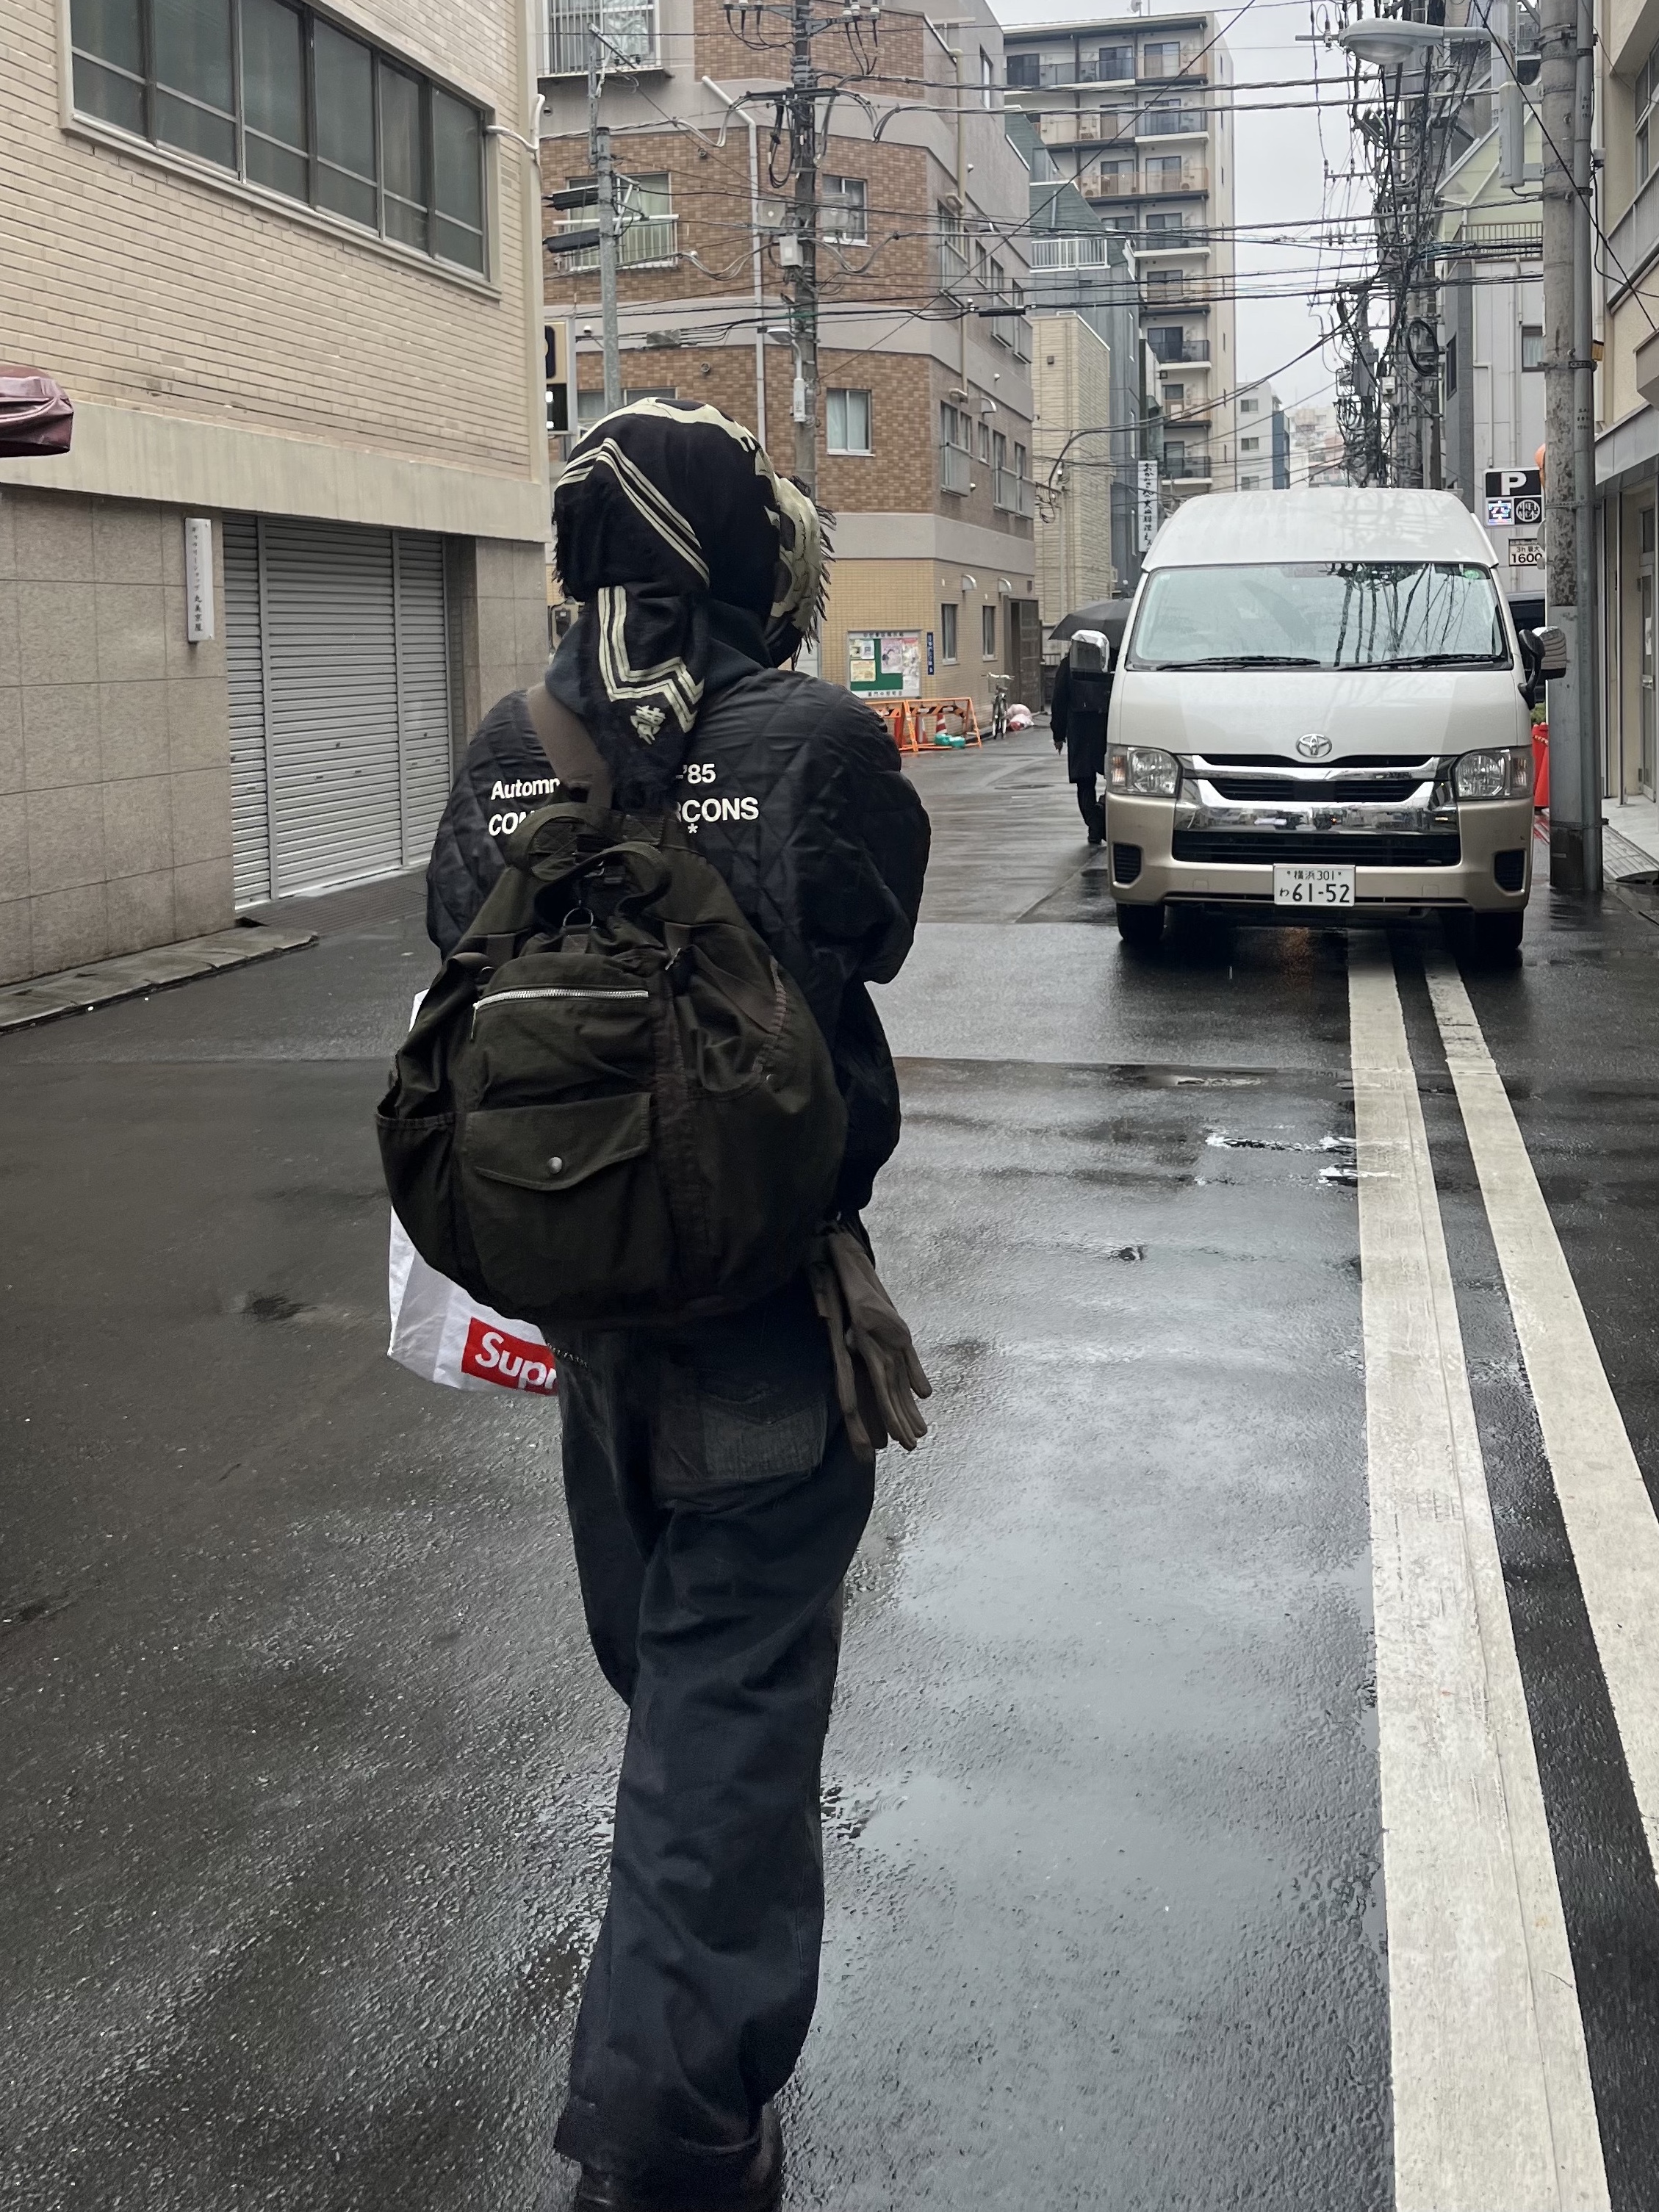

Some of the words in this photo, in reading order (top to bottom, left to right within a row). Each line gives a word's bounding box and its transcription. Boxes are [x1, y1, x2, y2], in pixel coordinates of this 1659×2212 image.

[1501, 472, 1527, 496] P
[1488, 500, 1511, 523] 空
[1279, 887, 1289, 897] わ
[1292, 883, 1350, 903] 61-52
